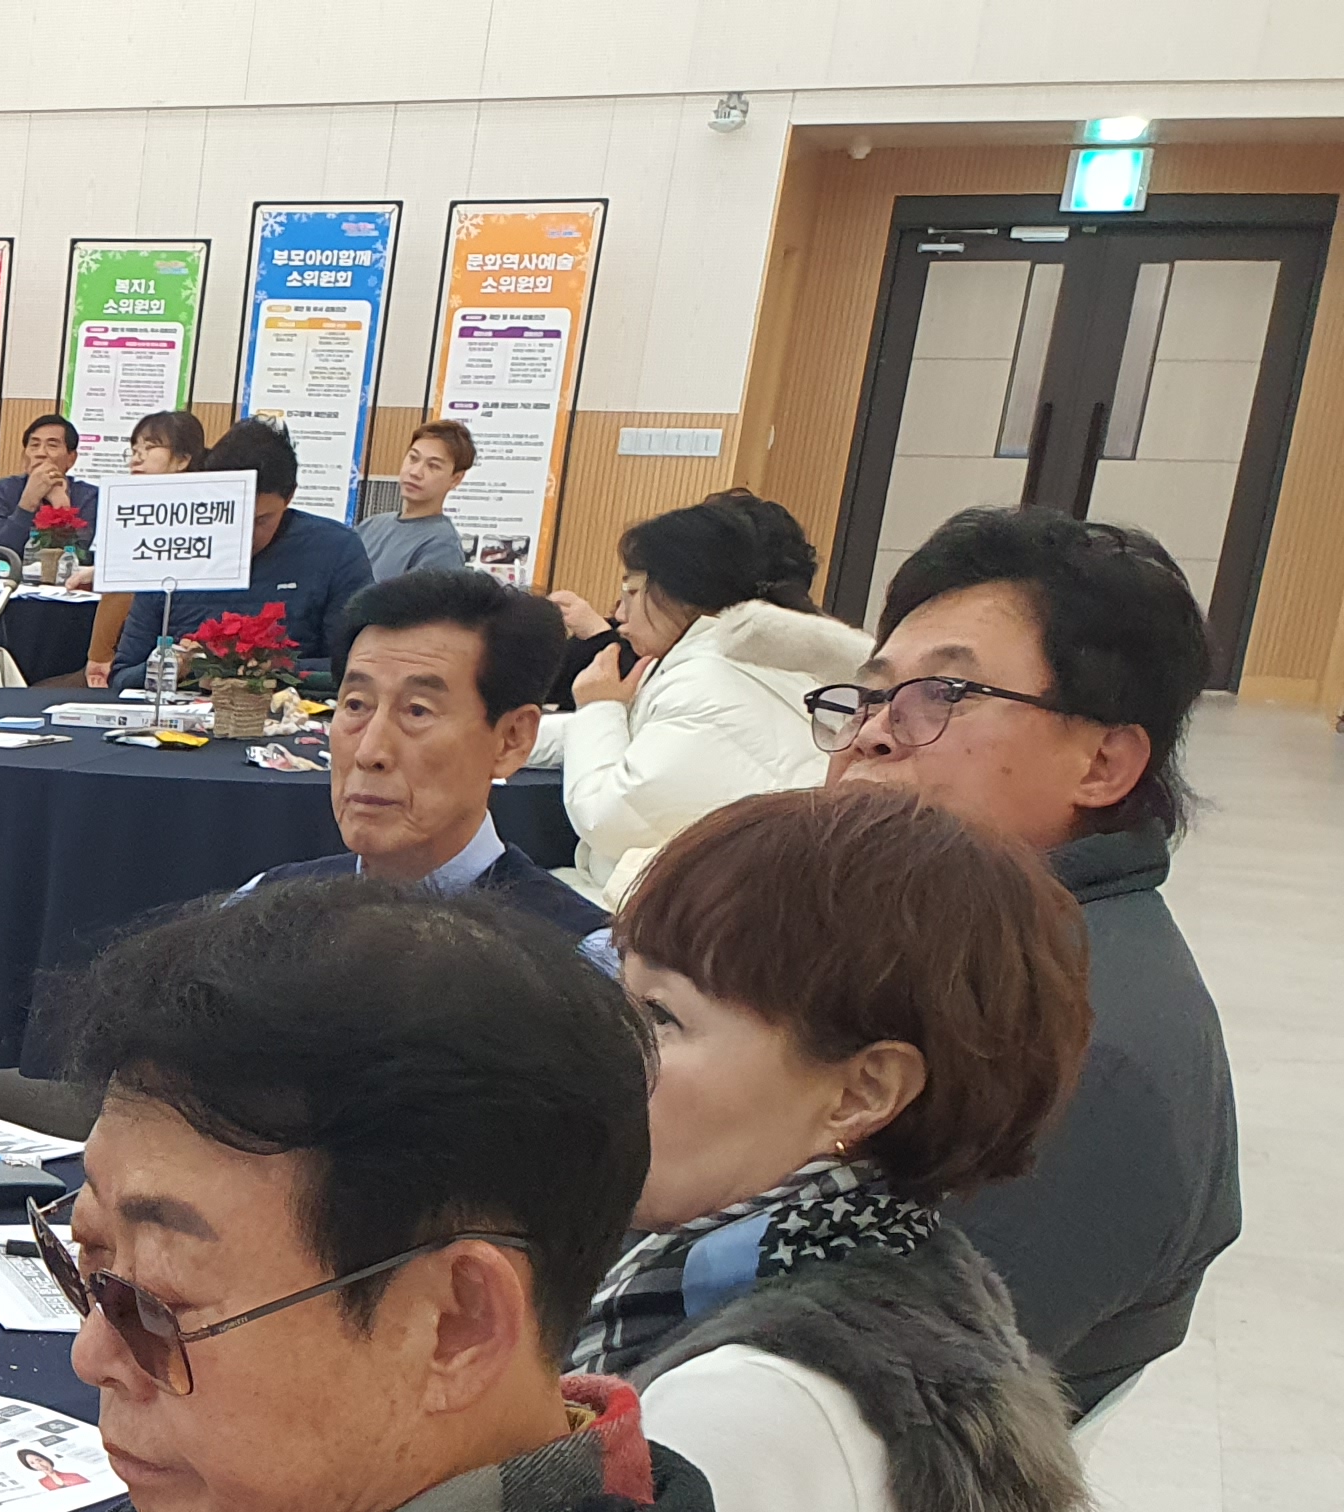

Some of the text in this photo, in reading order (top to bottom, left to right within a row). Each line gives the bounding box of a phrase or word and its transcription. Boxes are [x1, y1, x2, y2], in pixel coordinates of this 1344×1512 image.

[272, 249, 372, 267] 부모아이함께
[466, 253, 575, 271] 문화역사예술
[286, 270, 352, 288] 소위원회
[479, 275, 552, 293] 소위원회
[102, 299, 165, 315] 소위원회
[115, 499, 236, 529] 부모아이함께
[132, 536, 213, 561] 소위원회
